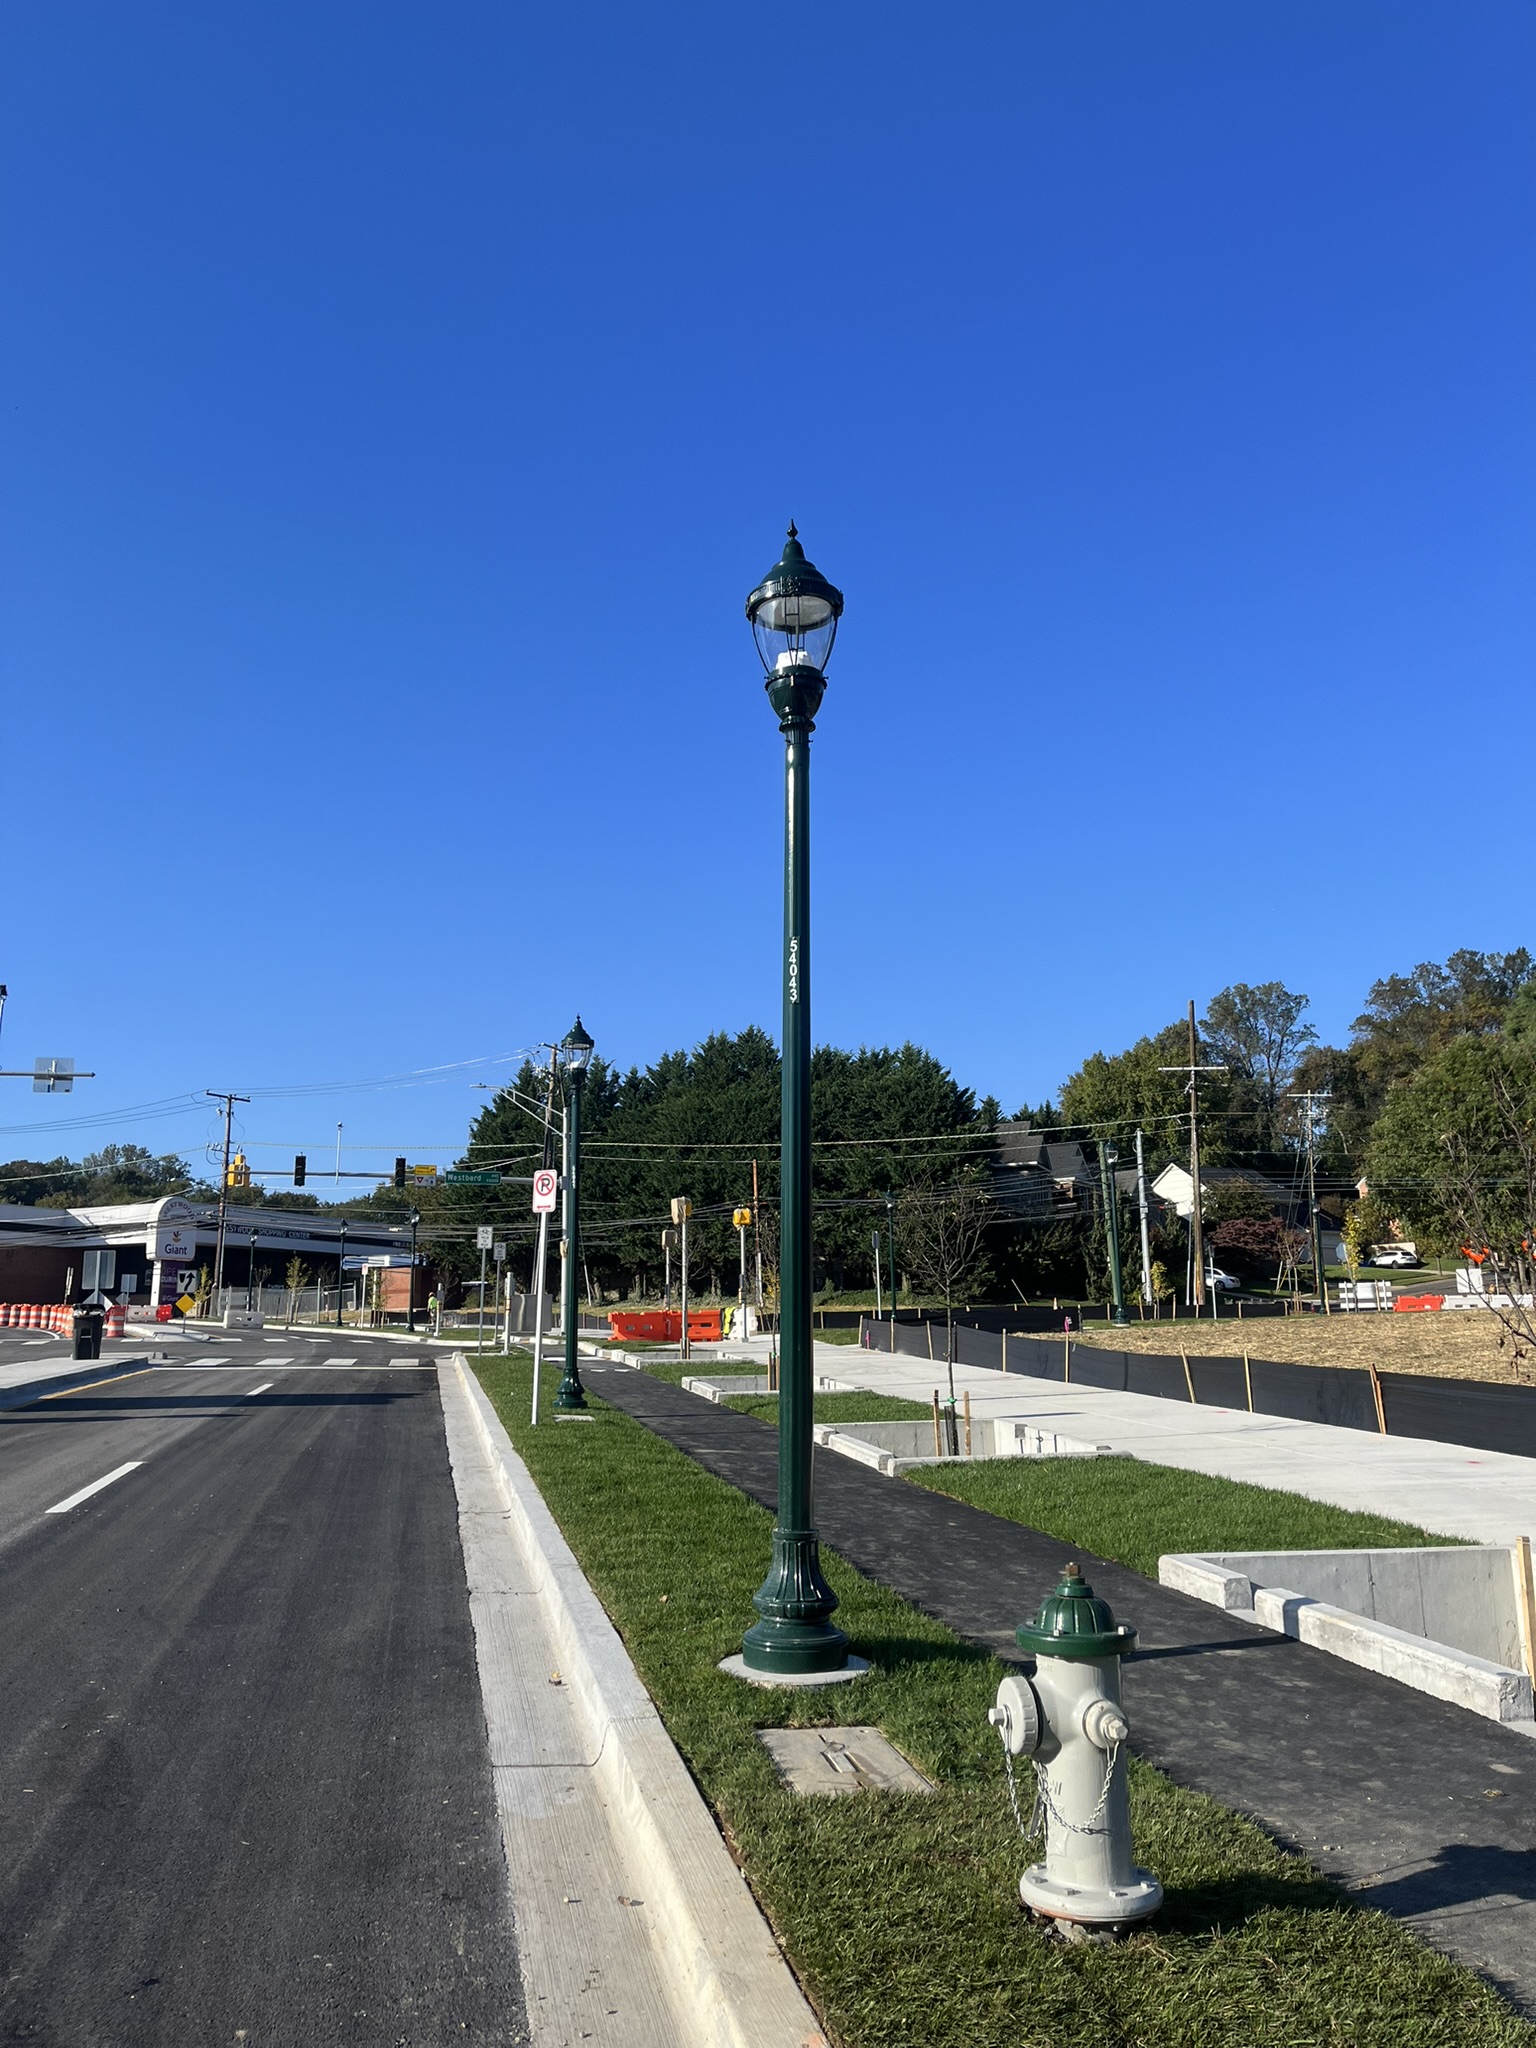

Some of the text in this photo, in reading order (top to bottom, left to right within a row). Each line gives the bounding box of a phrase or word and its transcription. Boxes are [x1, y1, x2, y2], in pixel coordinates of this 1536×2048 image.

[788, 939, 798, 1001] 54043
[447, 1173, 482, 1182] Westbard
[257, 1228, 286, 1238] SHOPPING
[288, 1231, 310, 1239] CENTER
[164, 1243, 187, 1255] Giant
[161, 1267, 177, 1276] OPE
